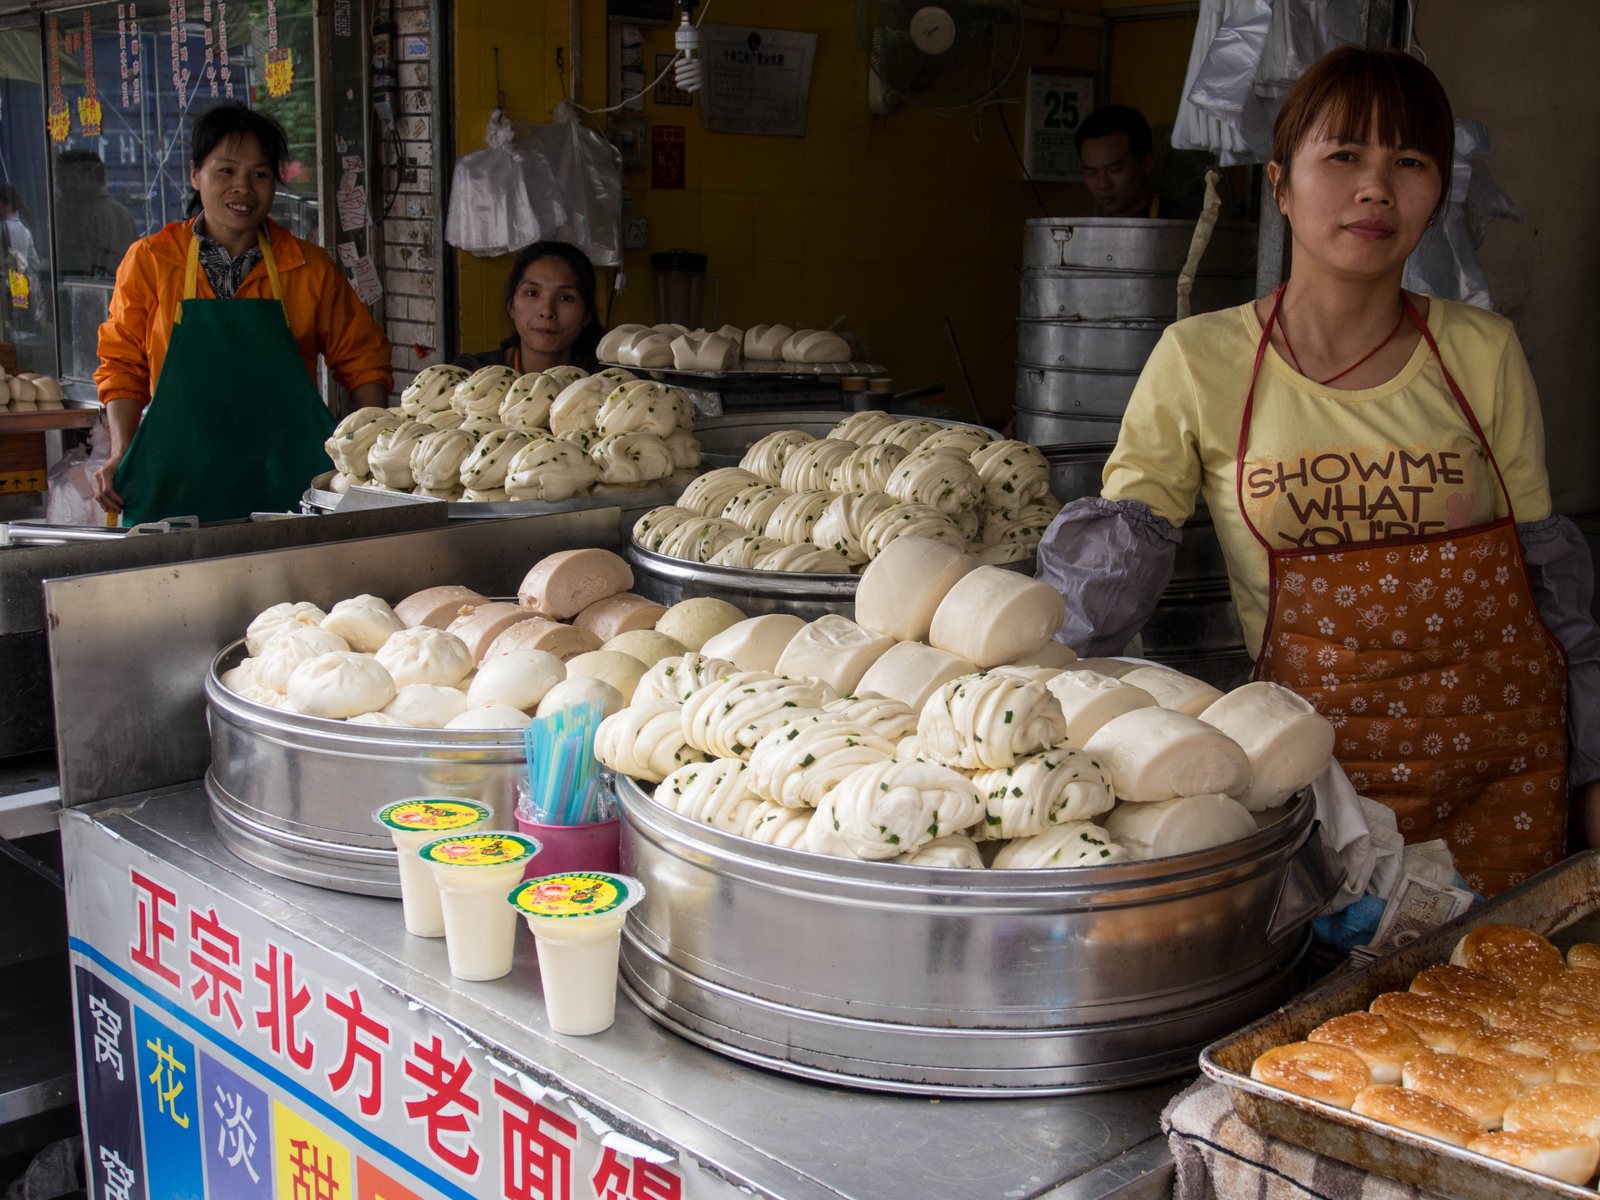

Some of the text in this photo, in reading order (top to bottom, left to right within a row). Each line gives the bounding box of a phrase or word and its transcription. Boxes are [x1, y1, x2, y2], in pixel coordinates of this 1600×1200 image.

[1043, 89, 1080, 129] 25
[1286, 484, 1434, 525] WHAT
[146, 1037, 190, 1129] 花
[213, 1084, 260, 1184] 淡
